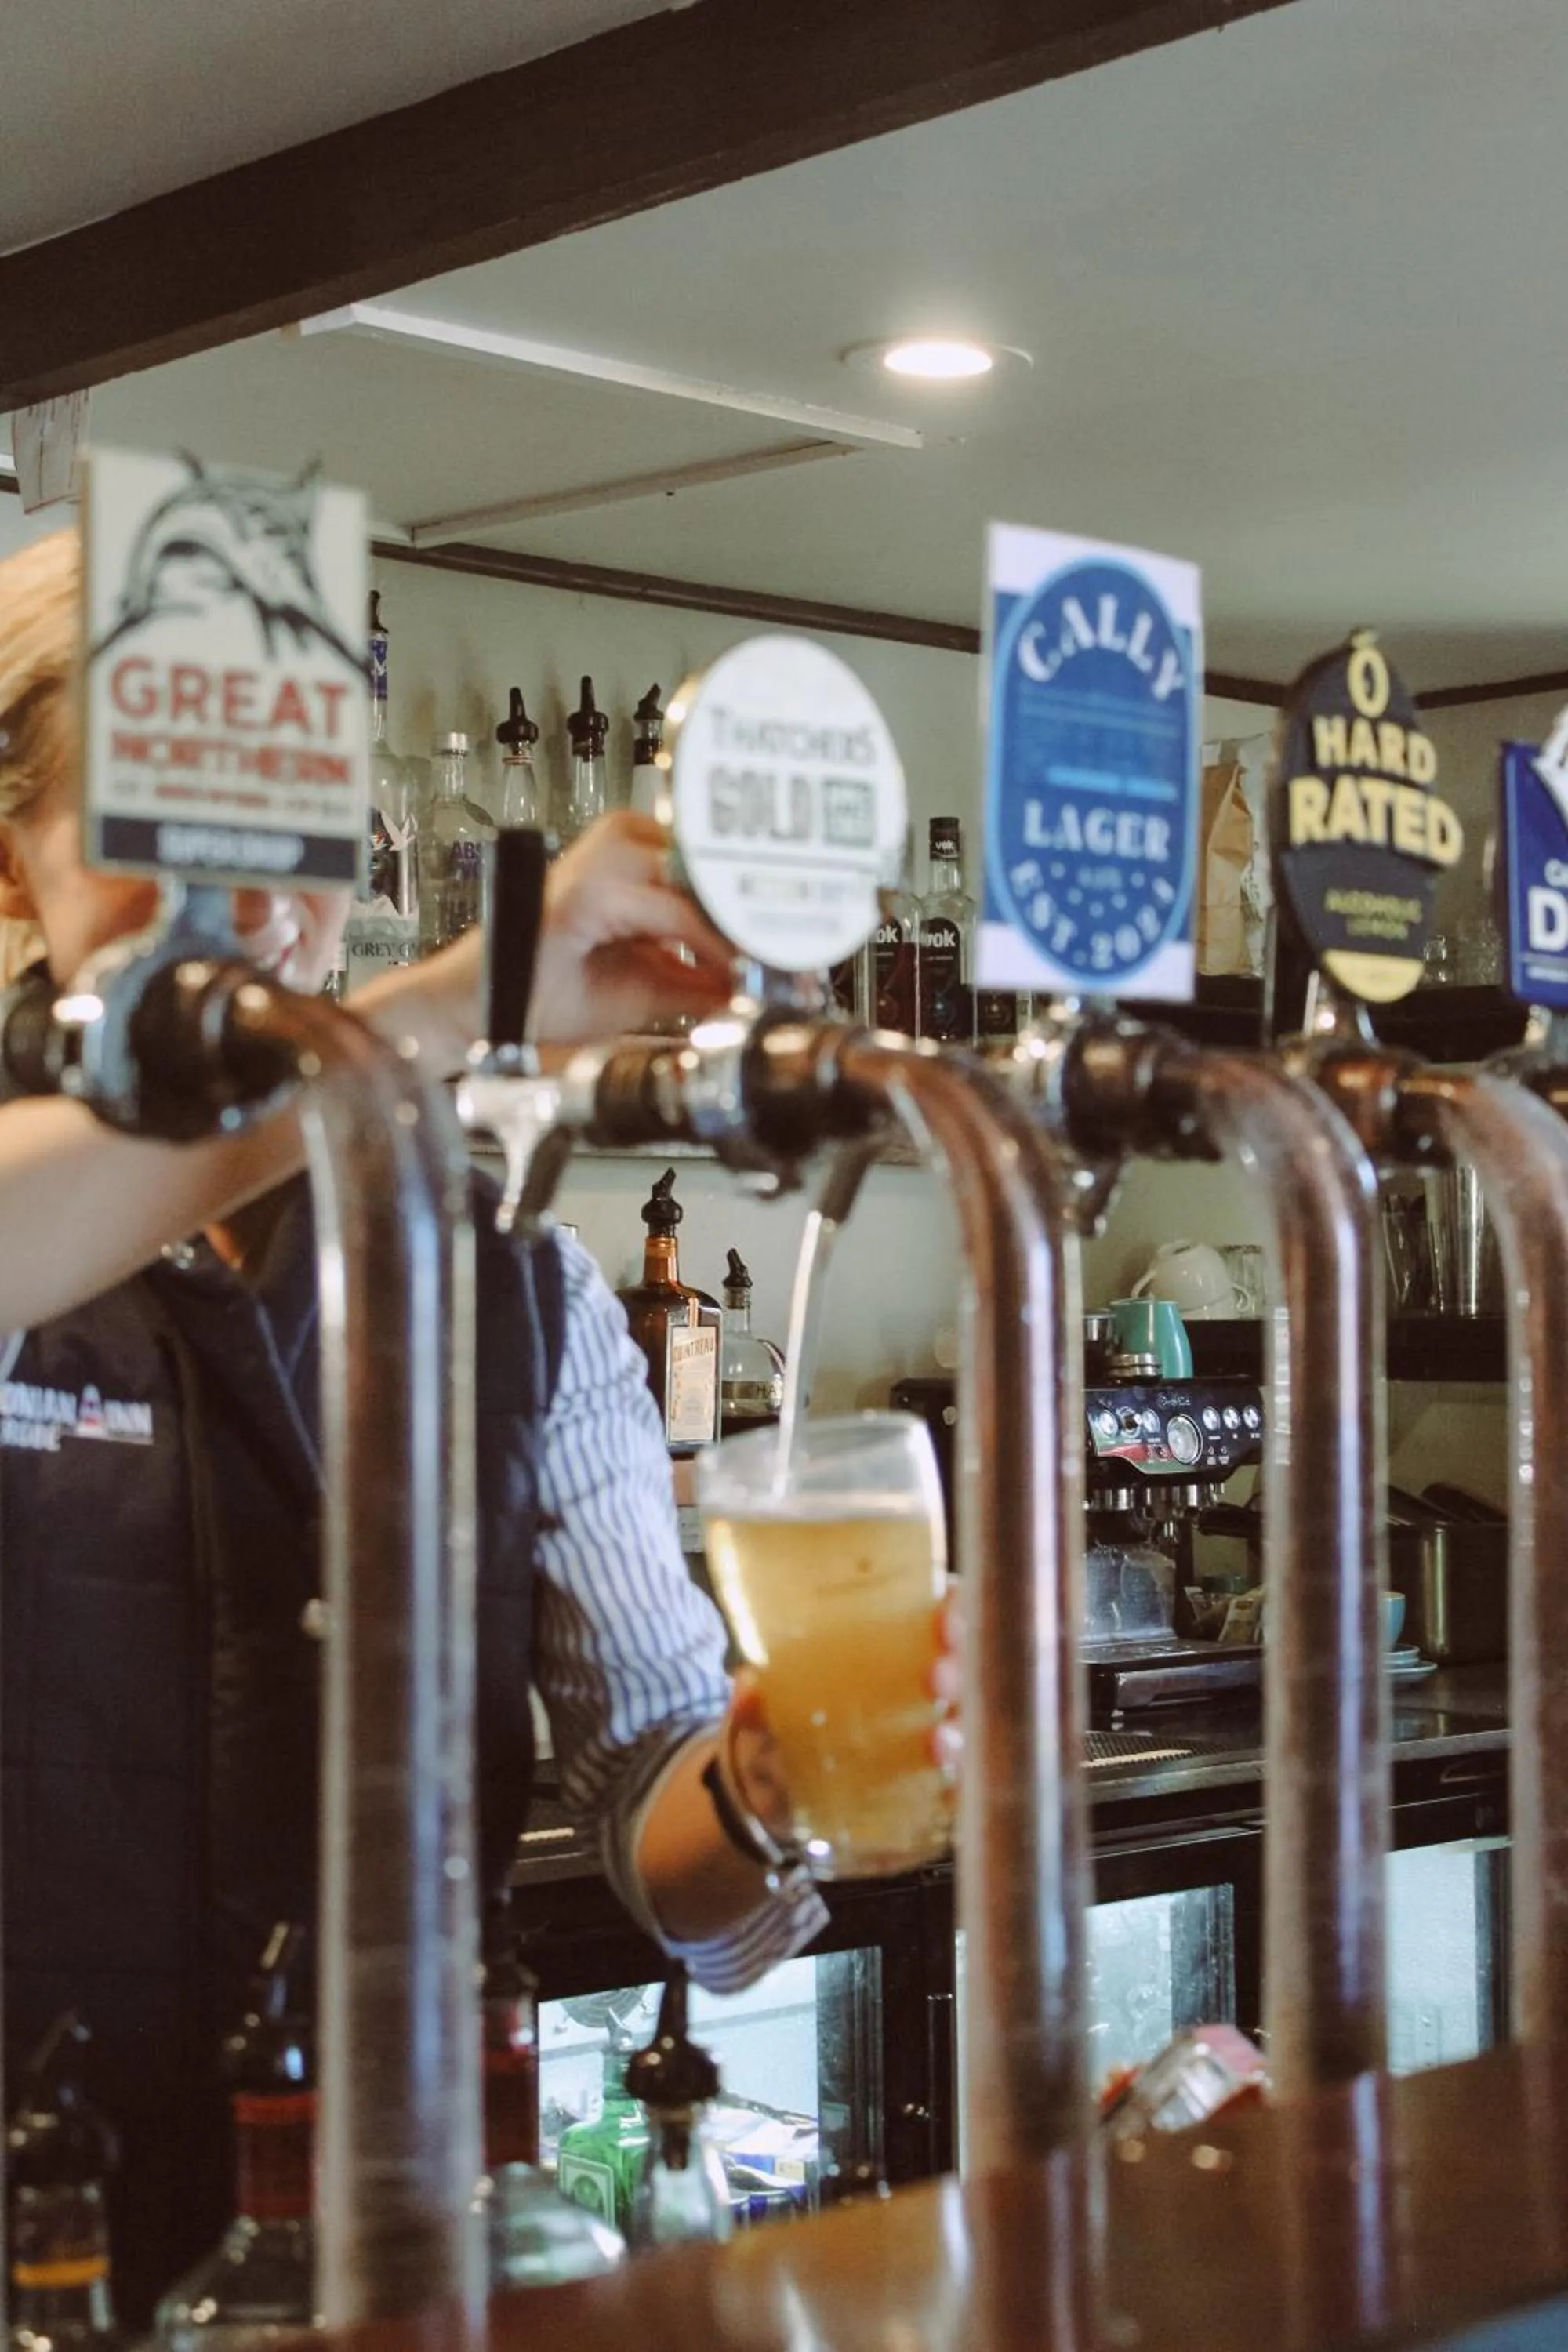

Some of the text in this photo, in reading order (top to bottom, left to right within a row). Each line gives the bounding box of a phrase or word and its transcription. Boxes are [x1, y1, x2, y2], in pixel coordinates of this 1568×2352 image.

[1018, 593, 1185, 701] CALLY
[109, 656, 350, 739] GREAT
[110, 731, 350, 782] NORTHERN
[1313, 715, 1437, 784] HARD
[935, 840, 954, 851] vok
[1023, 798, 1171, 862] LAGER
[1288, 775, 1464, 866] RATED
[352, 942, 391, 956] GREY
[877, 925, 898, 943] ok
